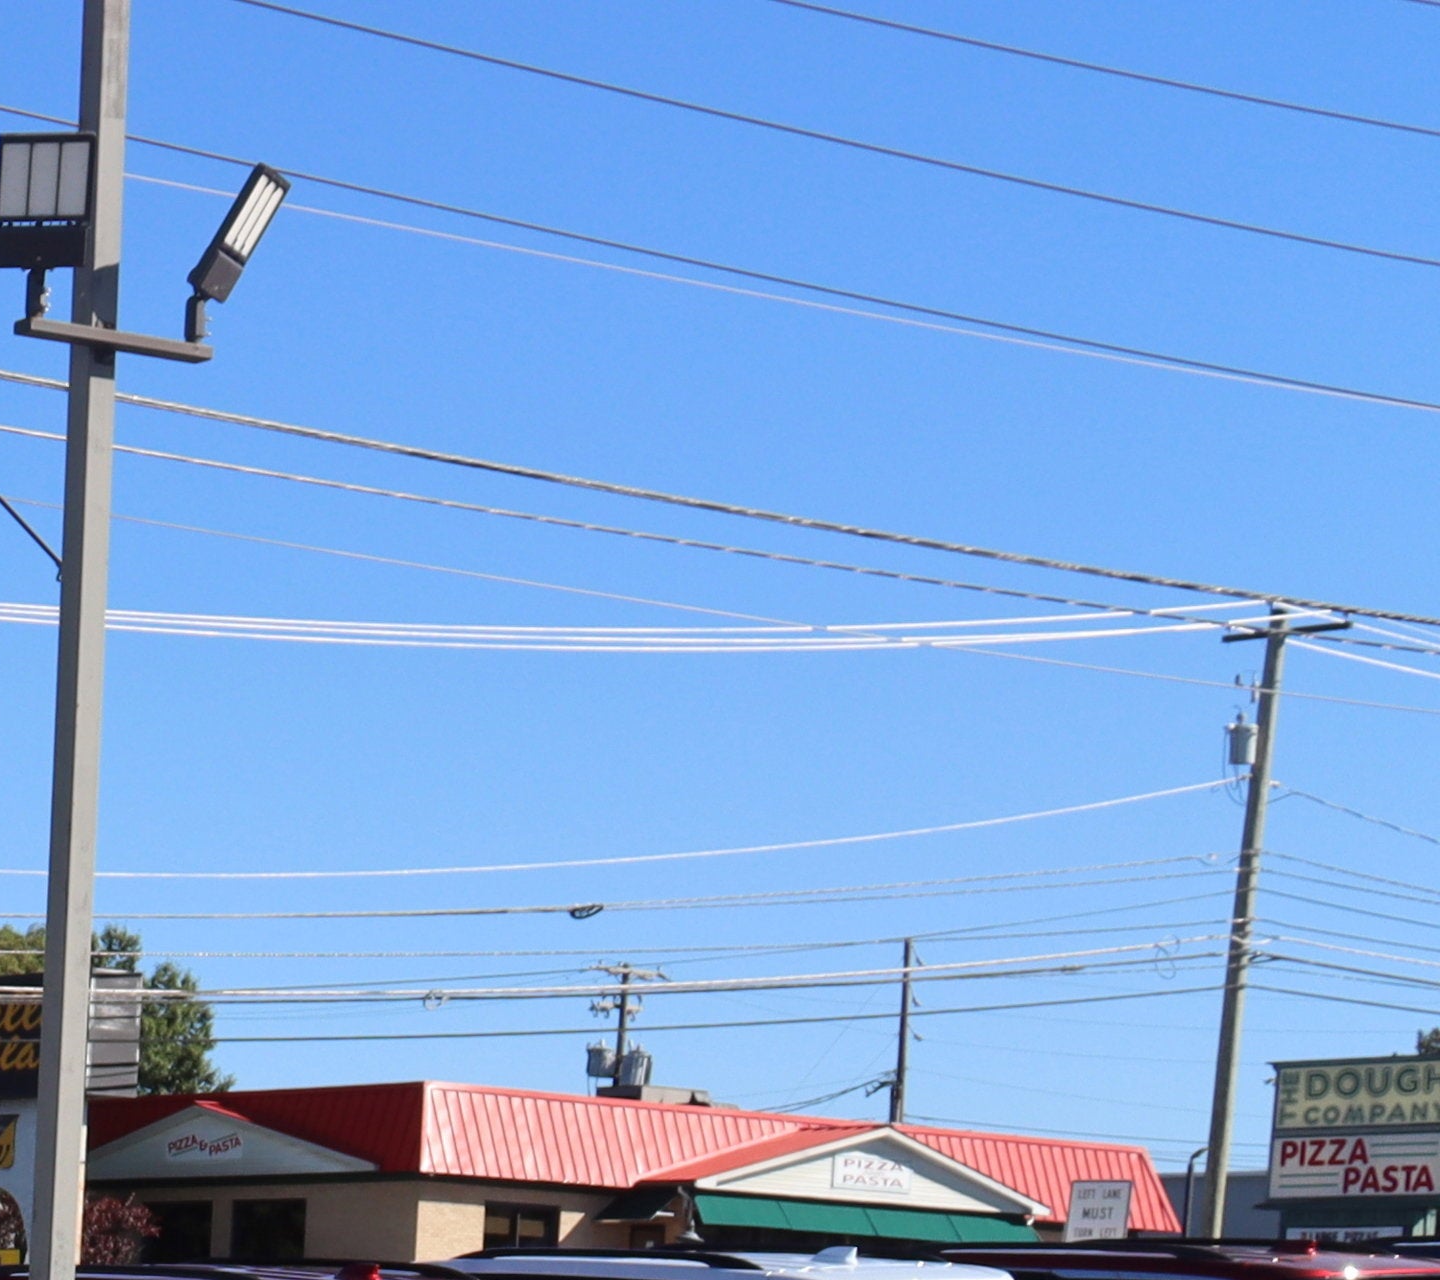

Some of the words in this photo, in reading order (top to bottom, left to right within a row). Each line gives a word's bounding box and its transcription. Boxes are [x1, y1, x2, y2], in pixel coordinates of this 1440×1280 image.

[1280, 1071, 1300, 1125] THE
[167, 1134, 198, 1154] PIZZA
[208, 1136, 242, 1156] PASTA
[1280, 1138, 1369, 1167] PIZZA
[842, 1157, 905, 1171] PIZZA
[841, 1173, 905, 1189] PASTA
[1342, 1165, 1435, 1193] PASTA
[1077, 1188, 1096, 1199] LEFT
[1102, 1188, 1123, 1199] LANE
[1082, 1206, 1114, 1219] MUST
